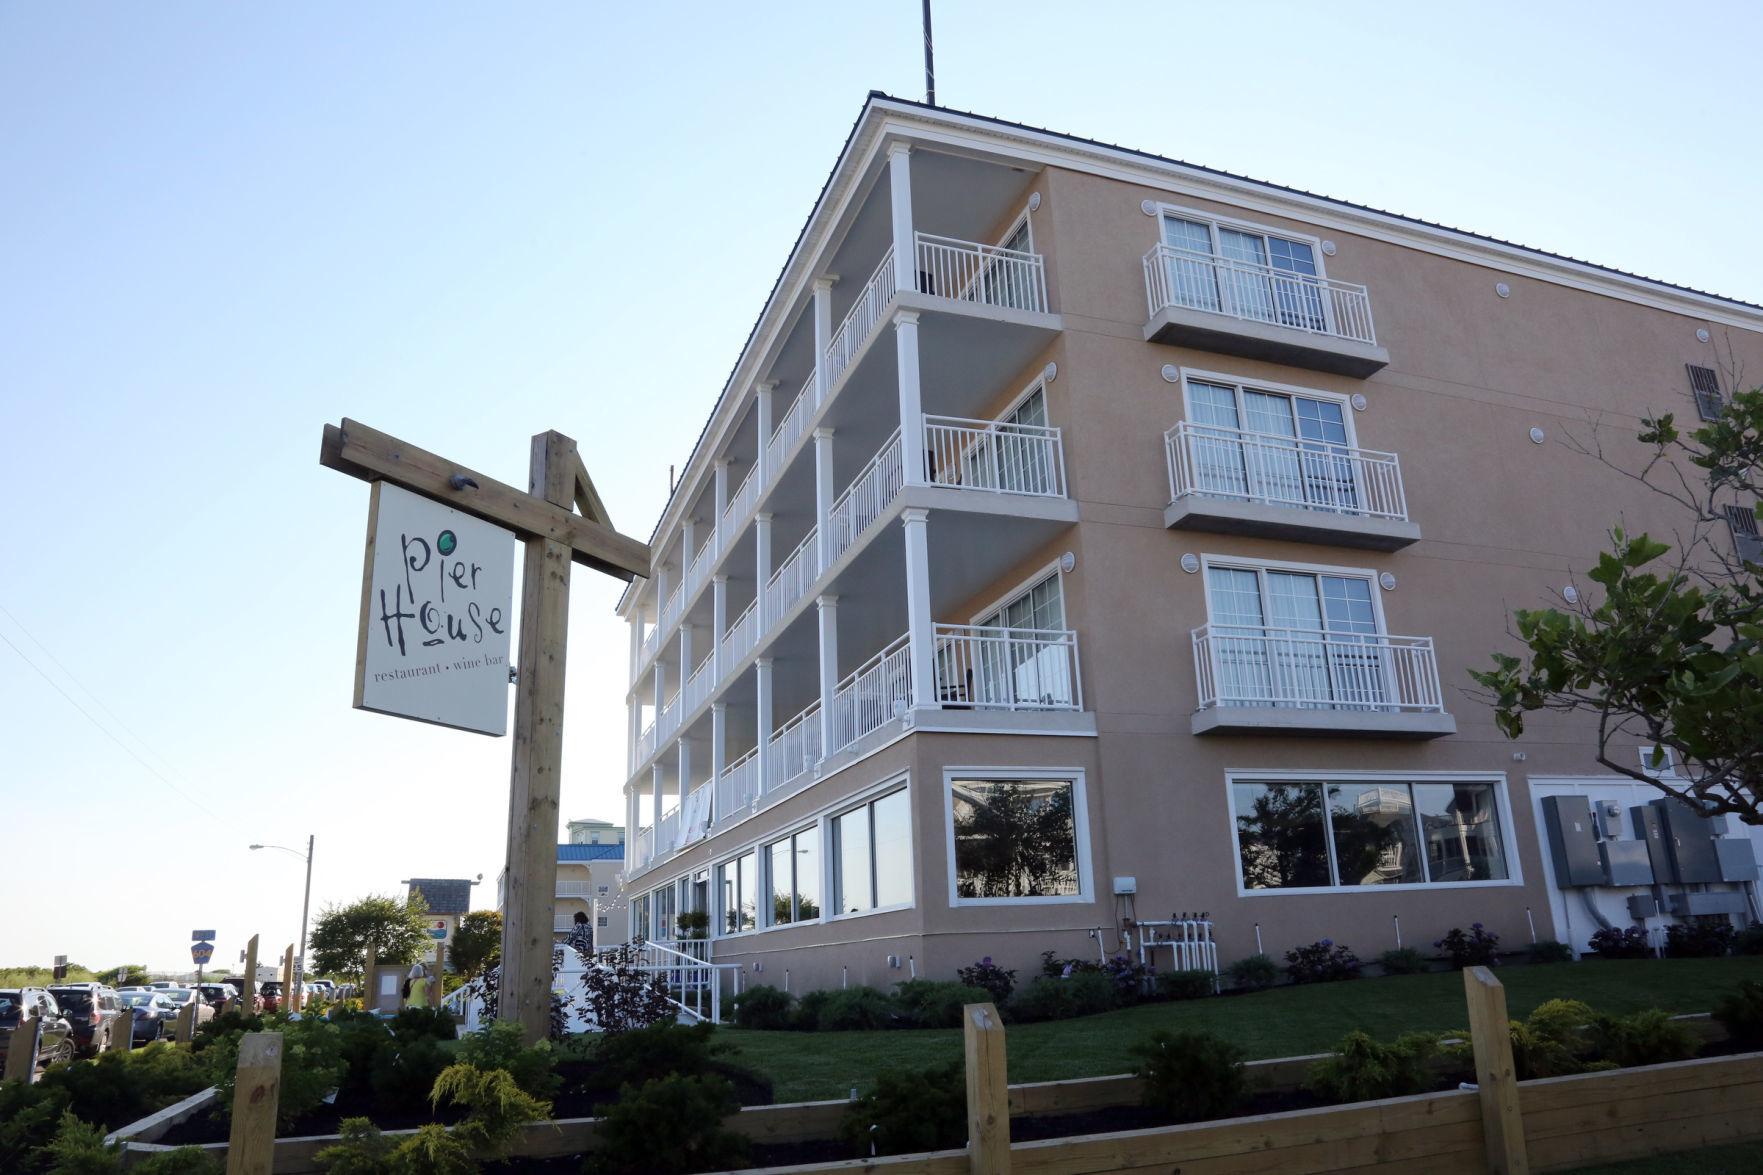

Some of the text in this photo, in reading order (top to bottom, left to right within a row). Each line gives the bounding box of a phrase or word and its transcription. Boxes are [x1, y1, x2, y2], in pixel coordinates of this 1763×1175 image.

[401, 530, 482, 604] Pier
[380, 584, 504, 656] House
[374, 653, 503, 683] restaurant wine bar
[192, 949, 213, 959] 604
